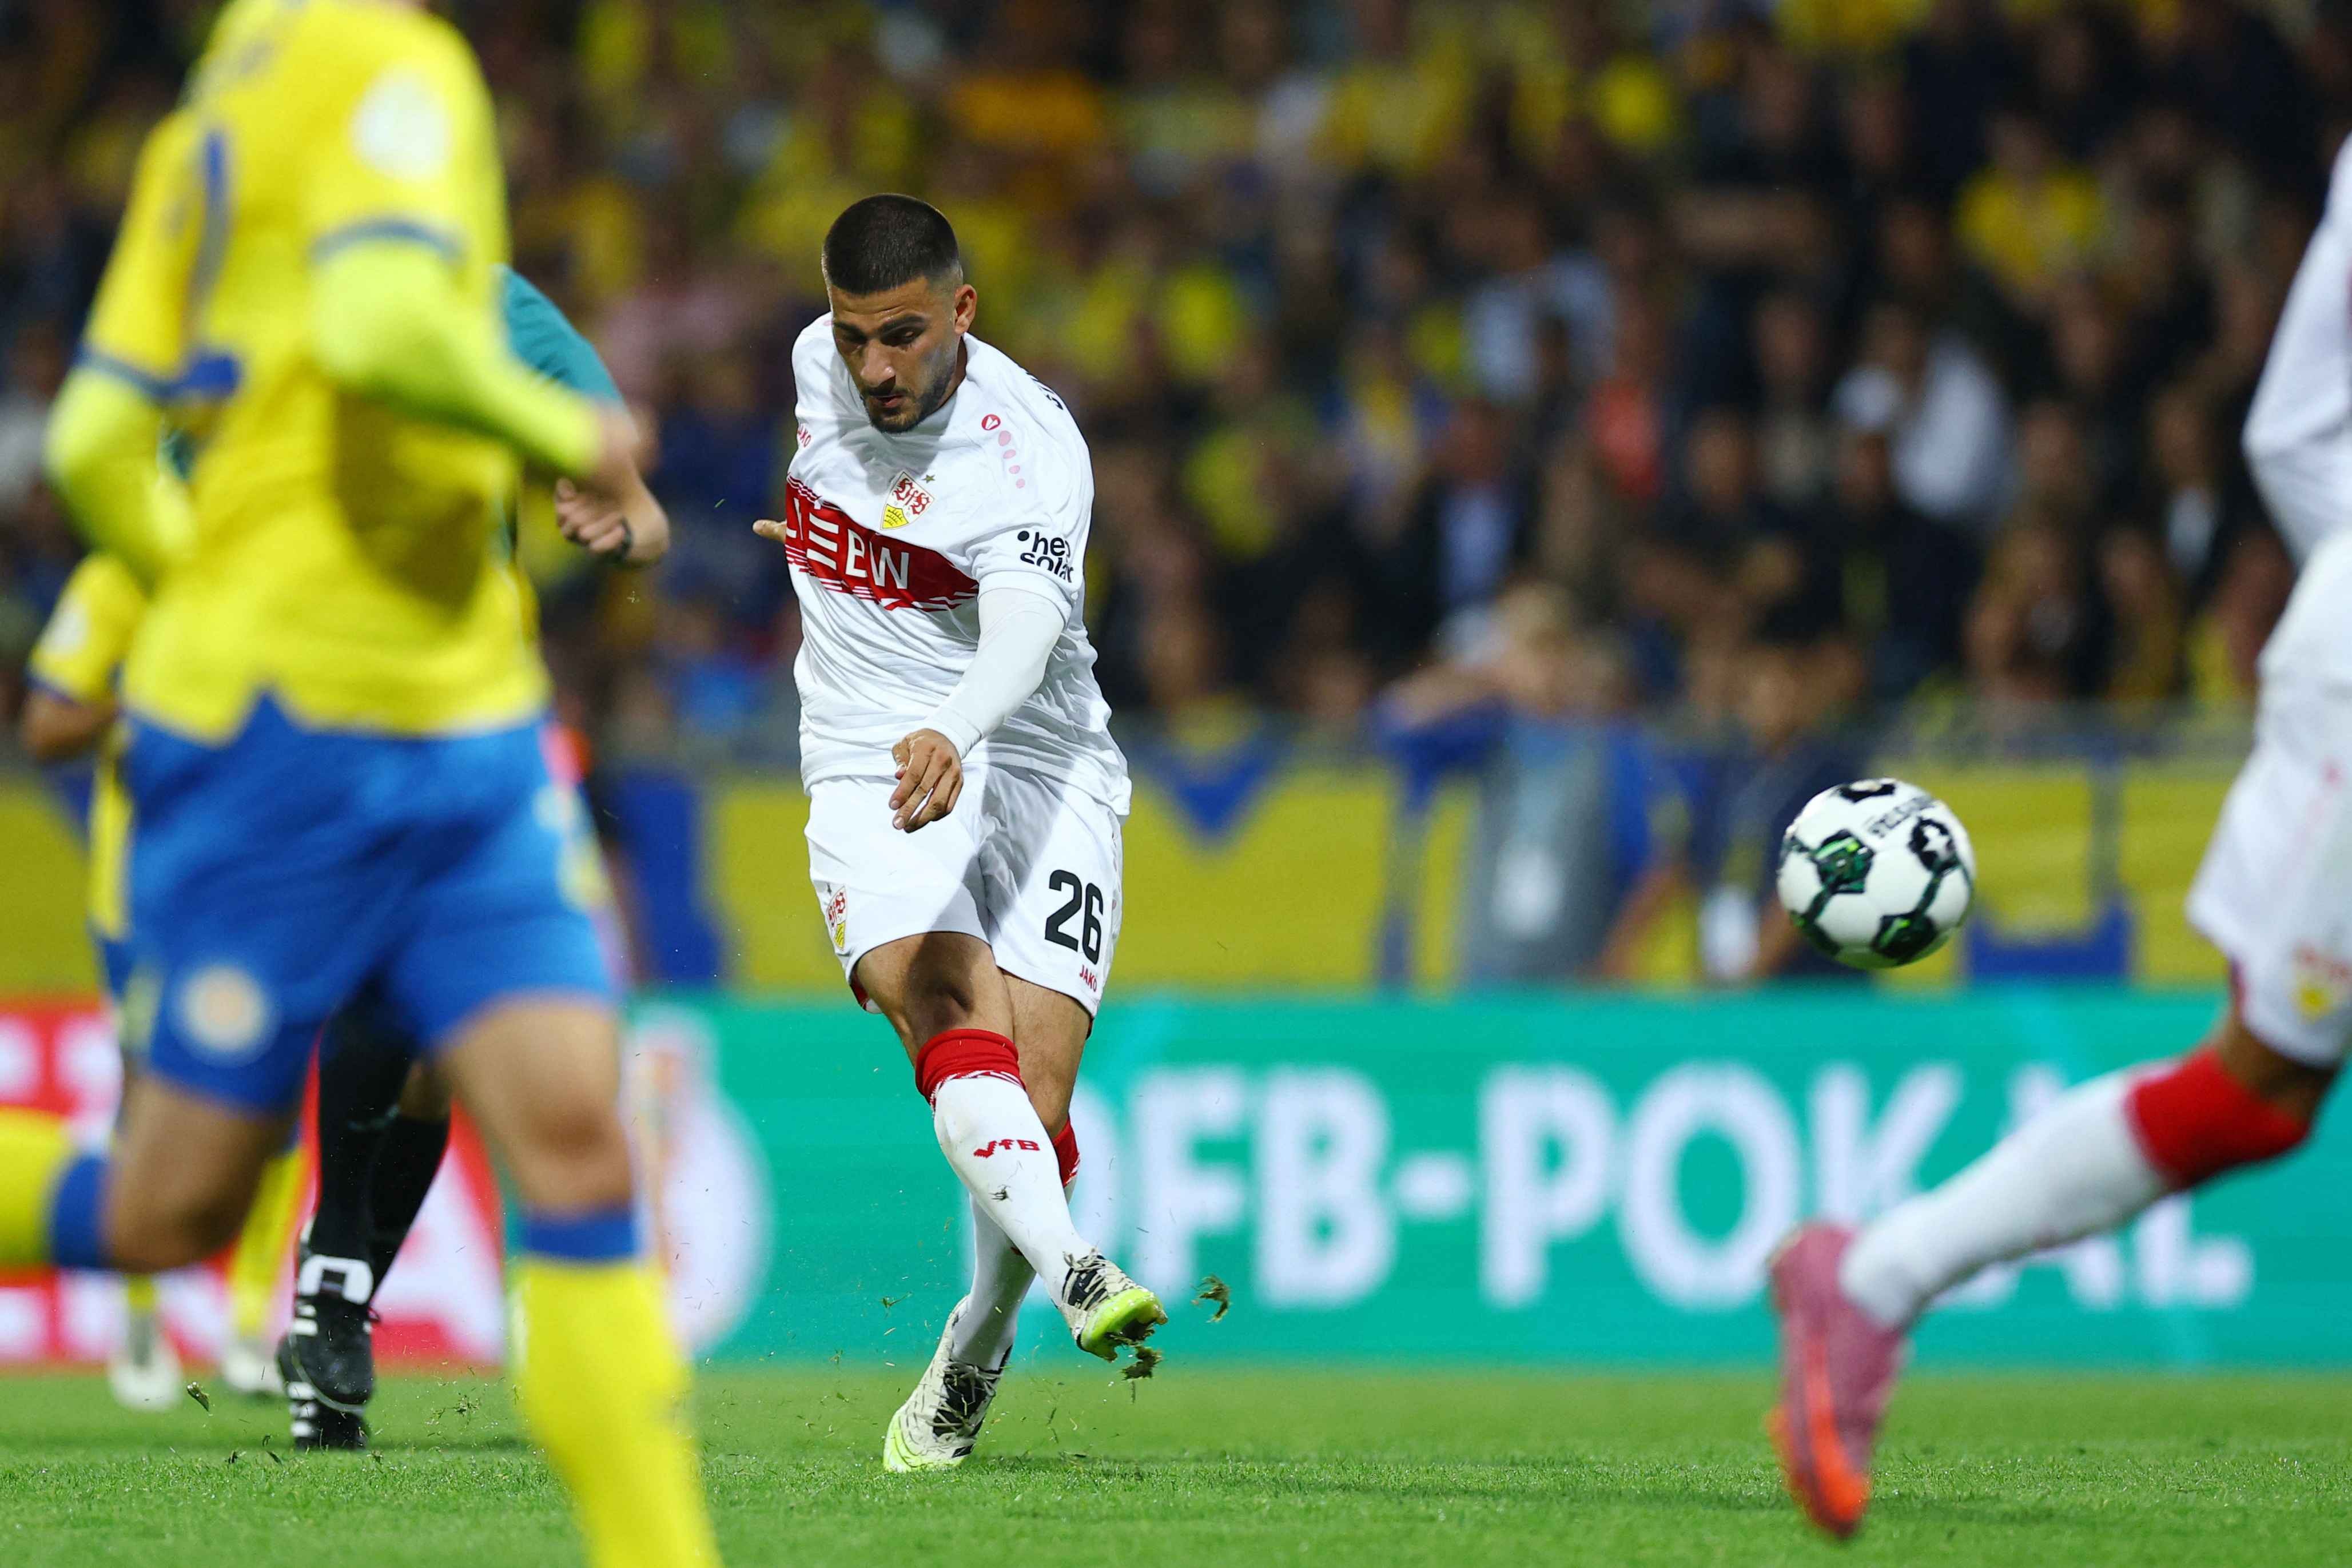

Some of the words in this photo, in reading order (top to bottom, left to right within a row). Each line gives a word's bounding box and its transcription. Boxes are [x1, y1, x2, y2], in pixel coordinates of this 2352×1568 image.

[1045, 869, 1103, 965] 26
[1079, 964, 1097, 992] JAKO
[973, 1139, 1040, 1159] VfB
